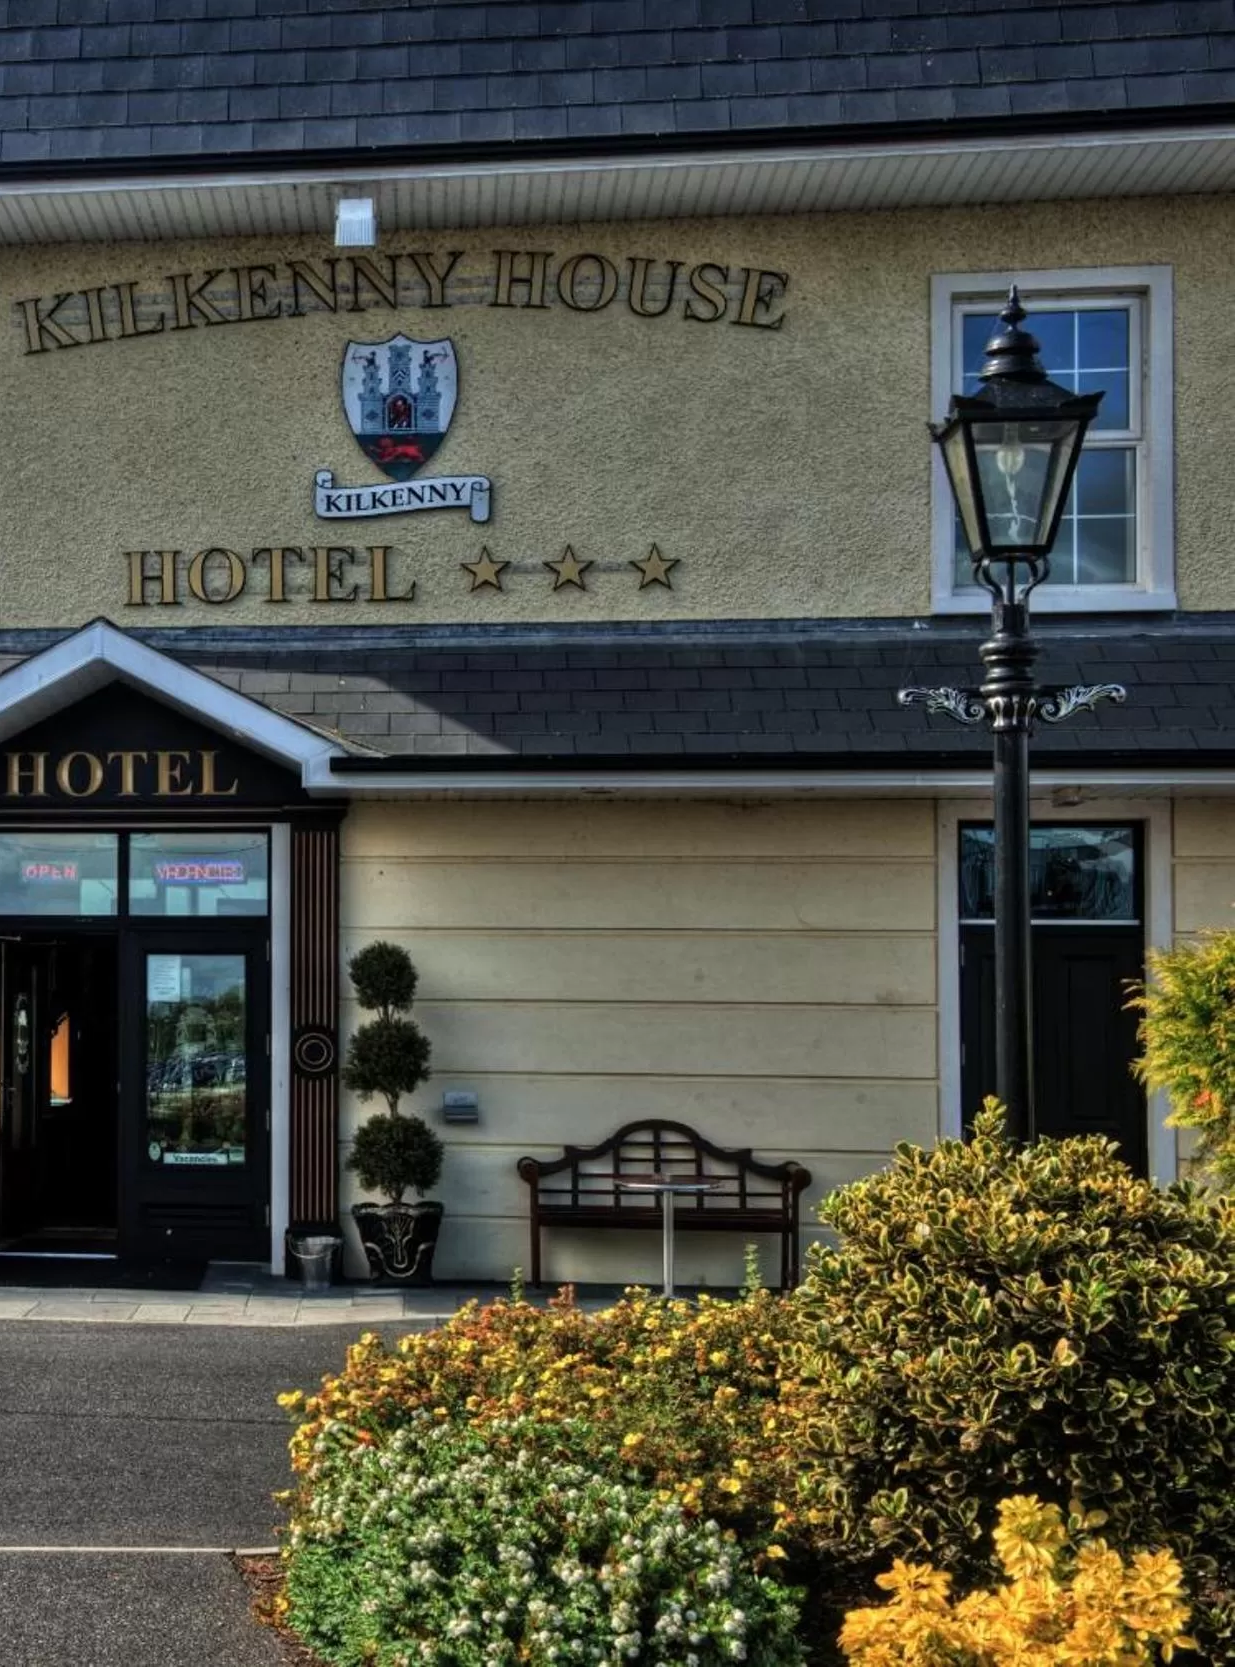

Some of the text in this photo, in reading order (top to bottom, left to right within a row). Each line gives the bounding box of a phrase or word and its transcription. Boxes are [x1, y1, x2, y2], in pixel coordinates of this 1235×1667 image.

[15, 249, 790, 356] KILKENNY HOUSE
[323, 482, 467, 514] KILKENNY
[123, 547, 417, 606] HOTEL
[0, 751, 239, 798] HOTEL
[25, 864, 77, 880] OPEN
